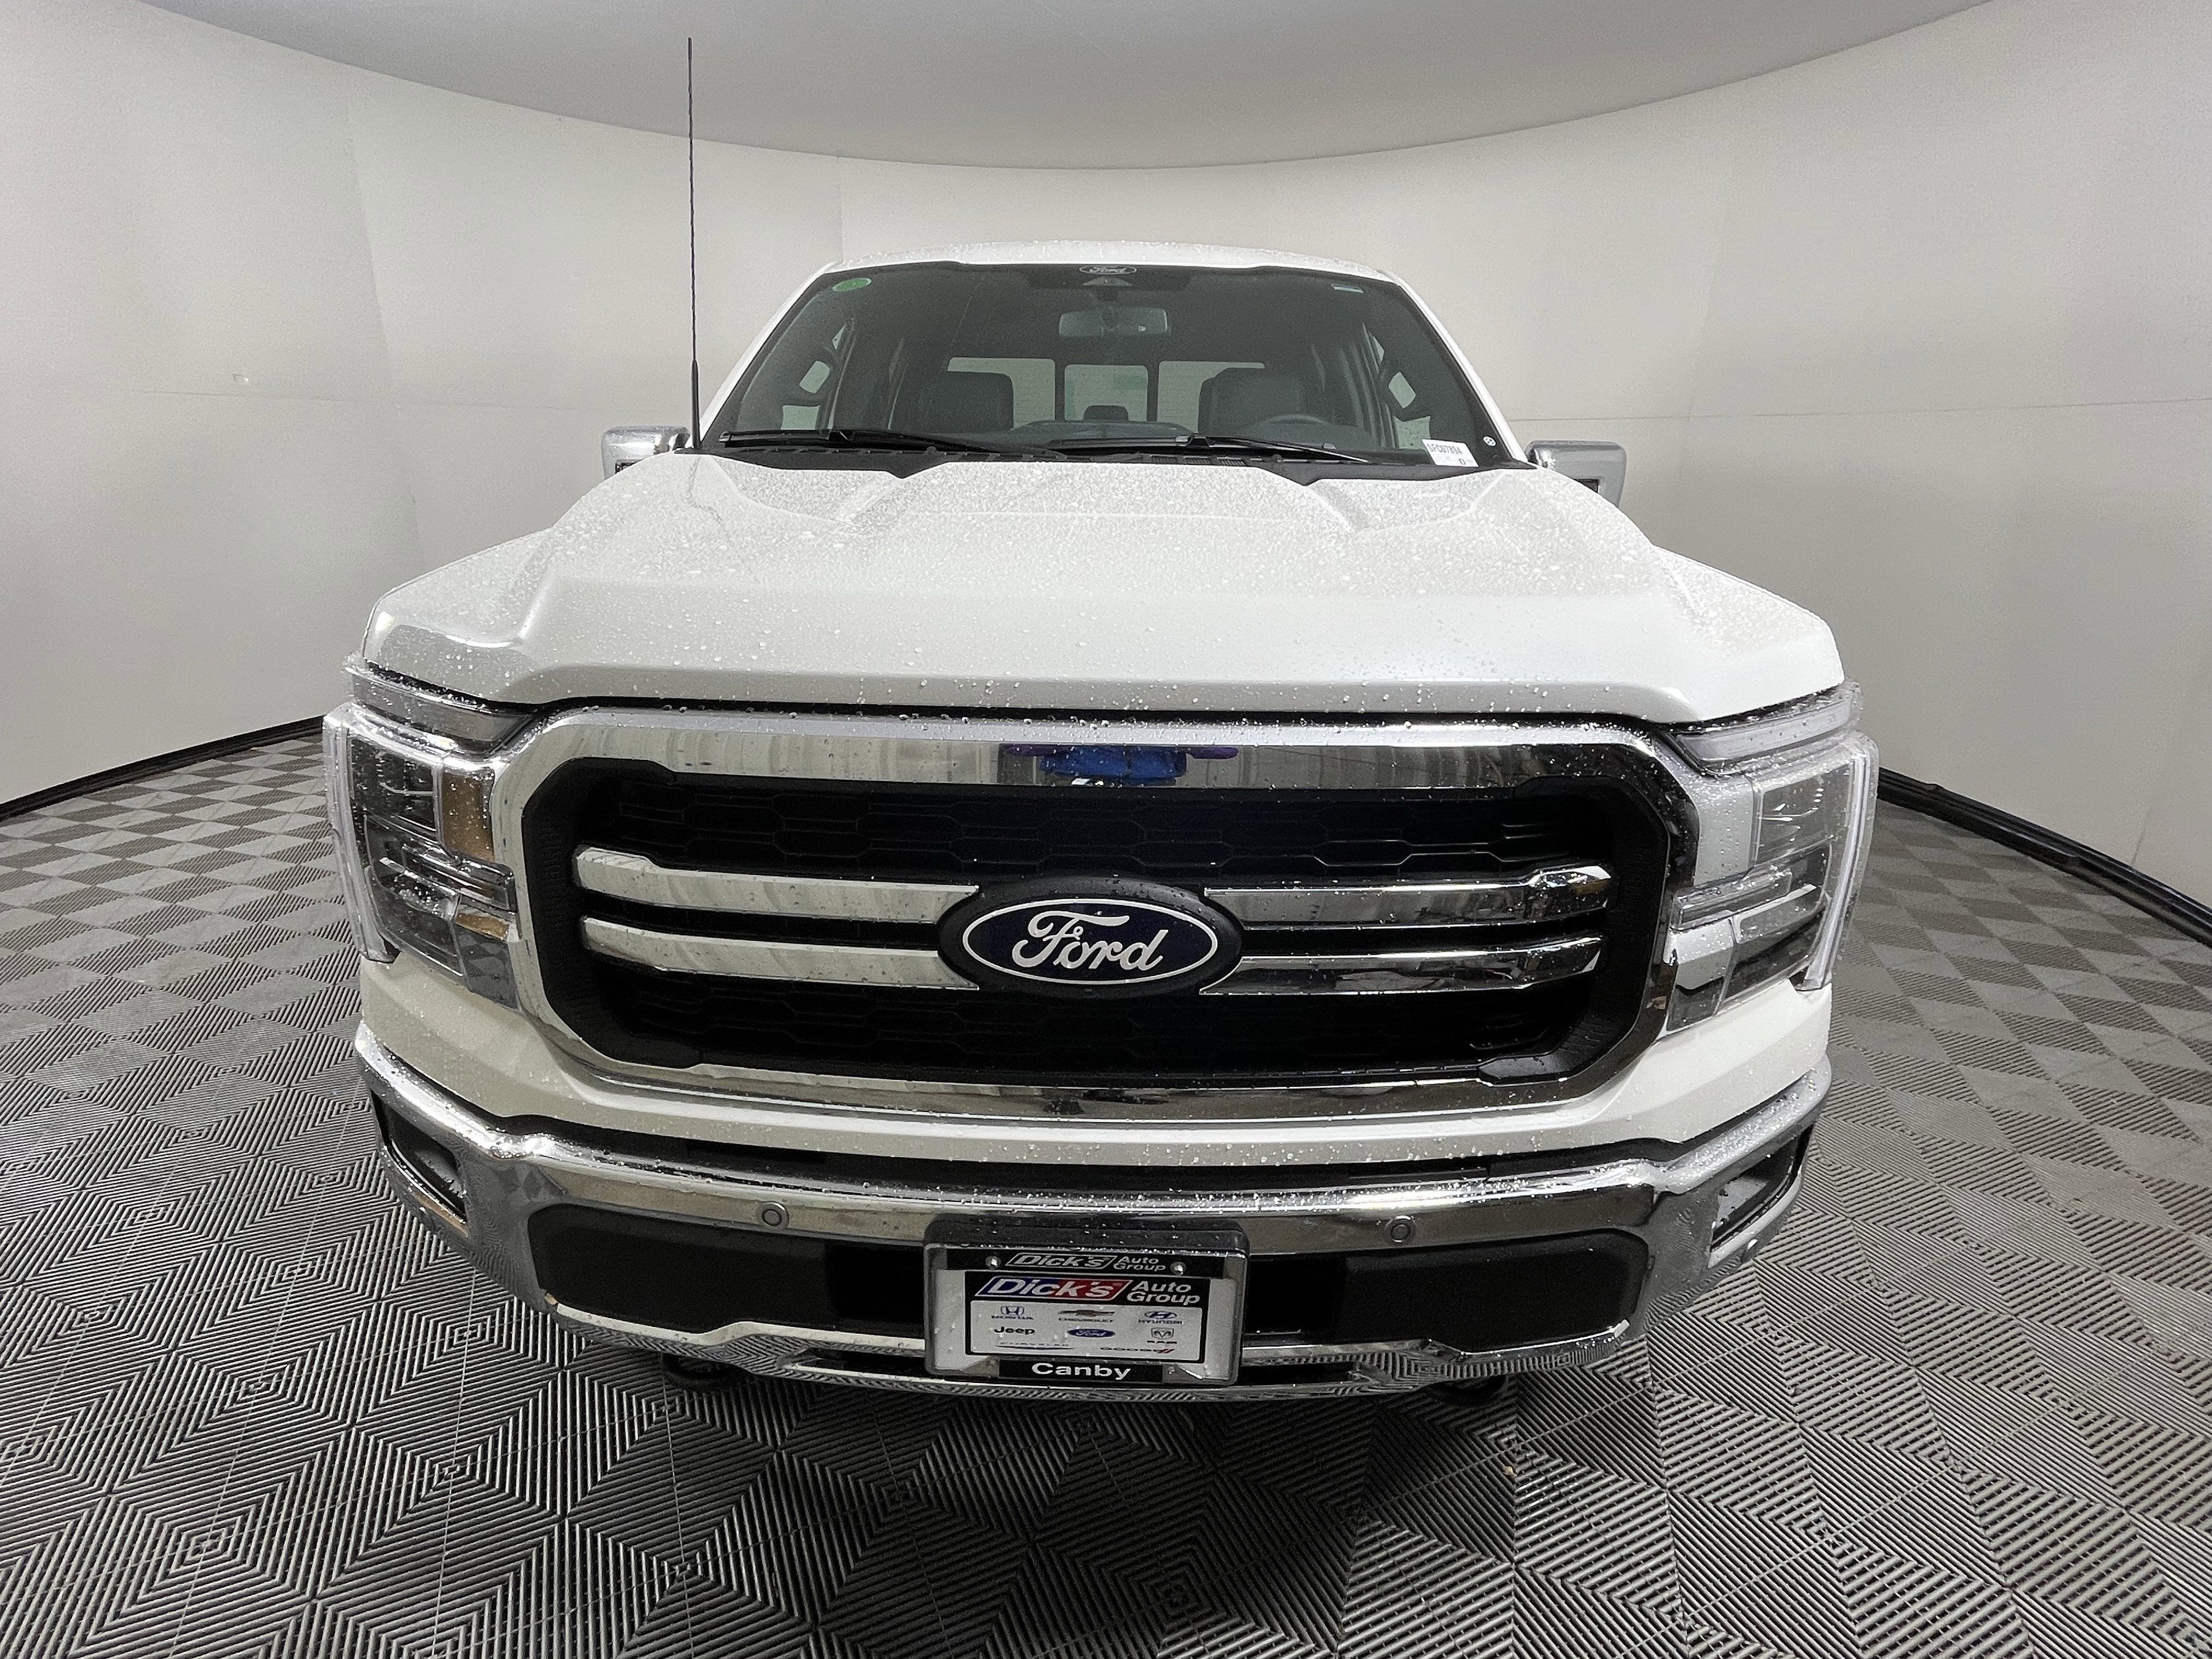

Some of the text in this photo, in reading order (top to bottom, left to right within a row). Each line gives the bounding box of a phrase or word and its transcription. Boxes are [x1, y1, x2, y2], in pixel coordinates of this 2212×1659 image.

[1012, 911, 1169, 971] Ford
[1013, 1255, 1104, 1267] Dick's
[1113, 1262, 1166, 1272] Group
[987, 1278, 1114, 1297] Dick's
[1131, 1280, 1192, 1293] Auto
[1126, 1291, 1200, 1306] Group
[994, 1326, 1036, 1335] Jeep
[1031, 1363, 1131, 1380] Canby
